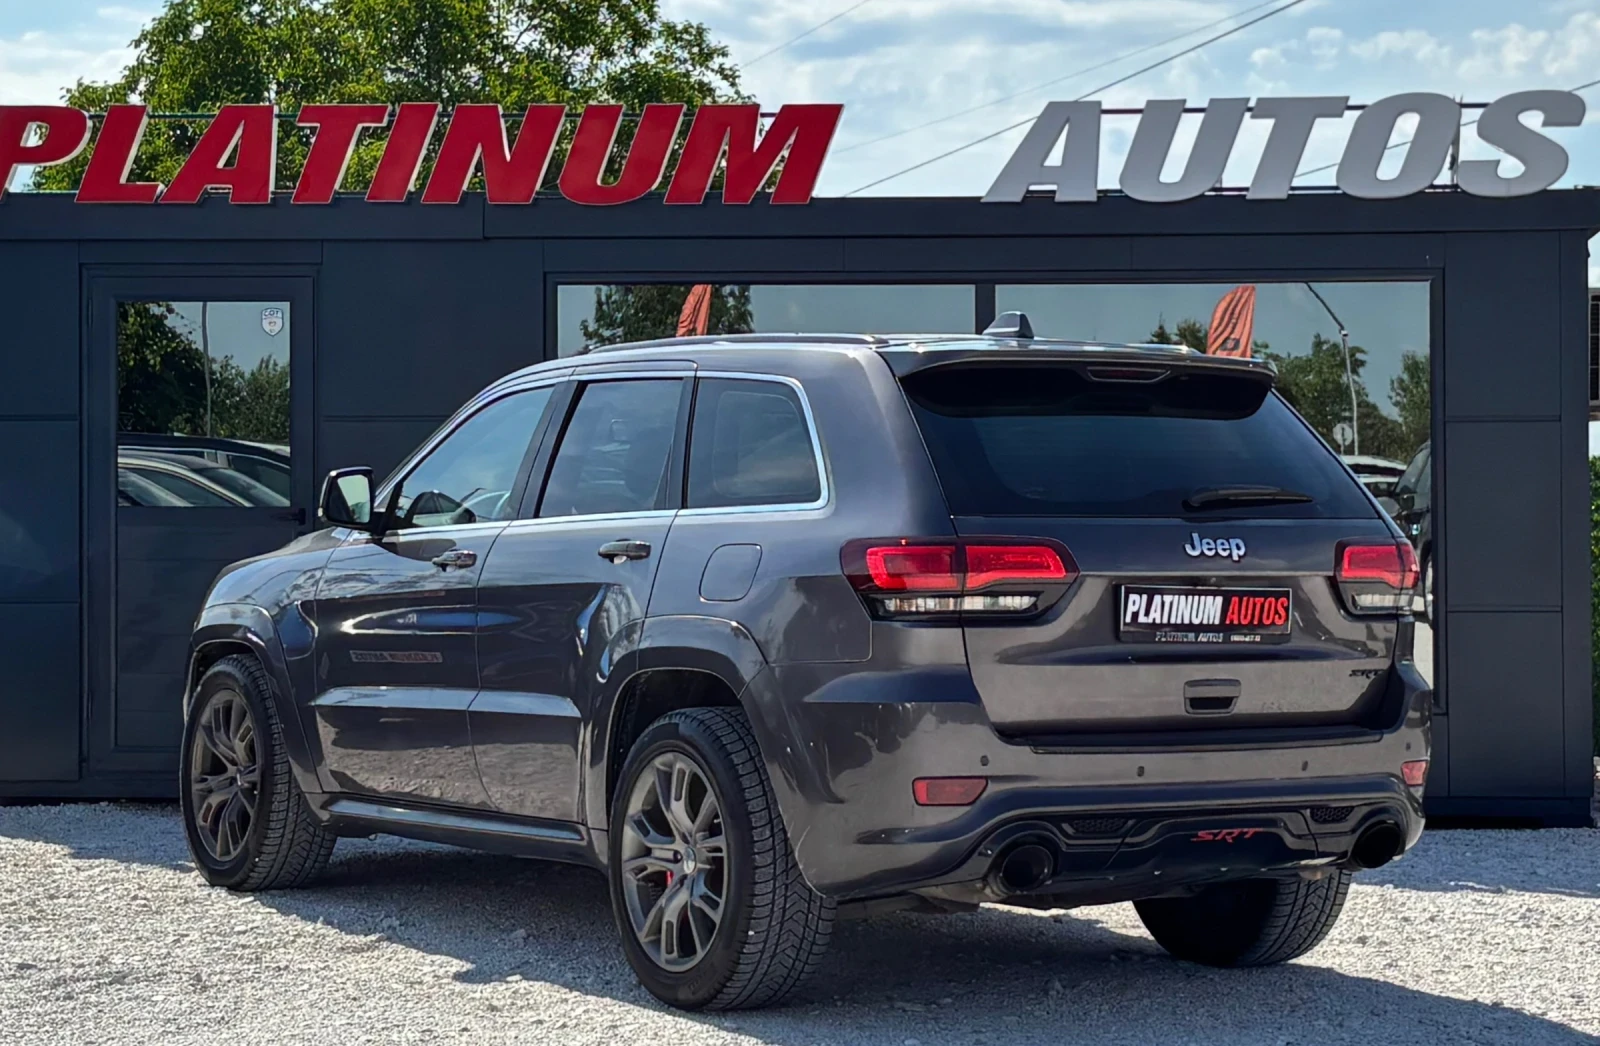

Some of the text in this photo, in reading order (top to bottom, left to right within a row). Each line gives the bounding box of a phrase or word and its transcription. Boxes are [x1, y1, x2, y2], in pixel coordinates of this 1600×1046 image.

[0, 103, 844, 204] PLATINUM
[981, 89, 1587, 203] AUTOS
[1184, 532, 1246, 561] Jeep
[1125, 594, 1288, 625] PLATINUM AUTOS
[1190, 827, 1264, 843] SRT
